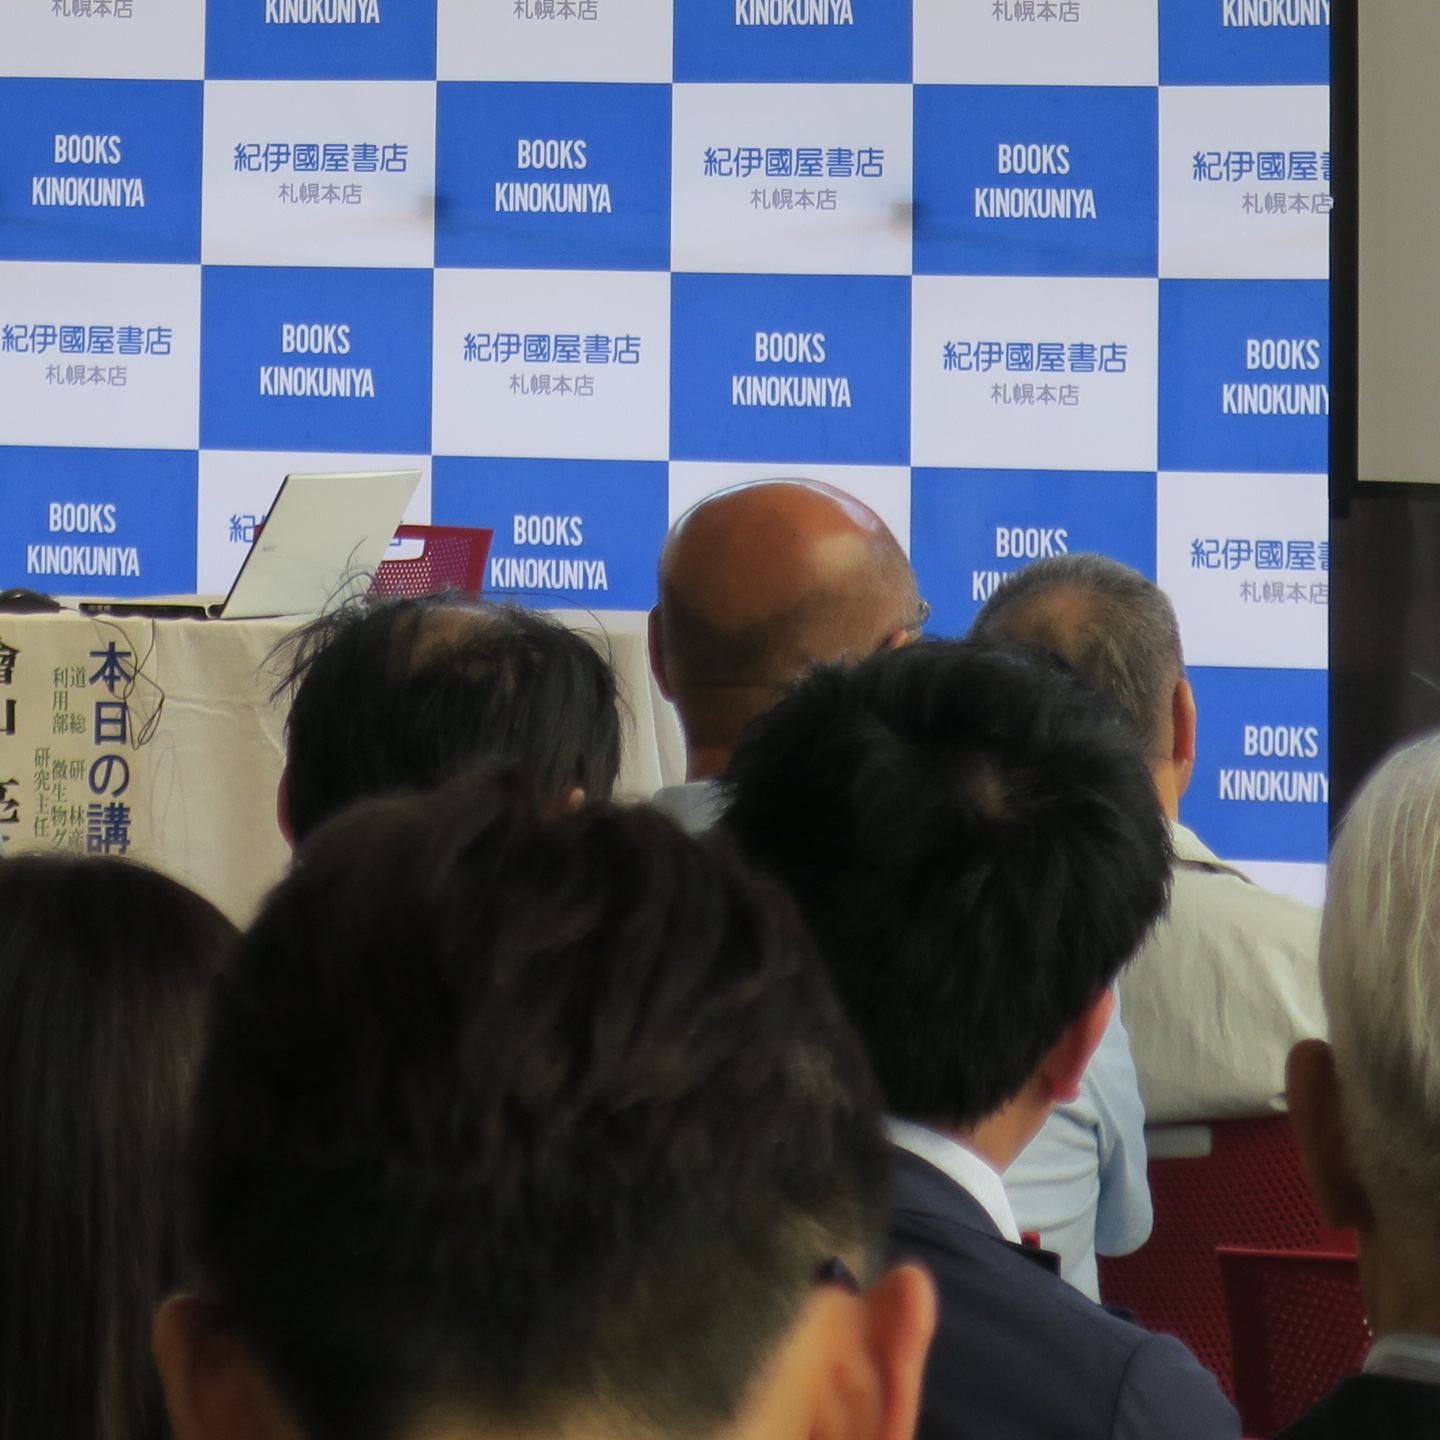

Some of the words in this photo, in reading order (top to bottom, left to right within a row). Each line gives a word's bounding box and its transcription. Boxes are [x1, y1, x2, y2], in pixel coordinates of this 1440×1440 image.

[514, 0, 597, 20] 札幌本店
[992, 0, 1079, 22] 札幌本店
[55, 135, 120, 164] BOOKS
[234, 143, 408, 172] 紀伊國屋書店
[518, 140, 586, 169] BOOKS
[704, 147, 884, 177] 紀伊國屋書店
[999, 144, 1069, 174] BOOKS
[33, 177, 144, 207] KINOKUNIYA
[279, 183, 361, 204] 札幌本店
[496, 183, 611, 213] KINOKUNIYA
[751, 188, 837, 210] 札幌本店
[975, 188, 1096, 218] KINOKUNIYA
[2, 324, 172, 355] 紀伊國屋書店
[283, 324, 350, 353] BOOKS
[464, 333, 640, 364] 紀伊國屋書店
[756, 333, 825, 362] BOOKS
[944, 342, 1127, 372] 紀伊國屋書店
[1247, 339, 1319, 369] BOOKS
[46, 364, 127, 386] 札幌本店
[261, 367, 374, 397] KINOKUNIYA
[510, 374, 593, 396] 札幌本店
[733, 376, 851, 407] KINOKUNIYA
[991, 383, 1078, 405] 札幌本店
[1223, 384, 1327, 416] KINOKUNIY
[50, 503, 116, 533] BOOKS
[514, 515, 582, 545] BOOKS
[997, 528, 1067, 557] BOOKS
[28, 545, 139, 576] KINOKUNIYA
[492, 559, 607, 590] KINOKUNIYA
[1245, 726, 1318, 757] BOOKS
[1220, 770, 1327, 802] KINOKUNIY
